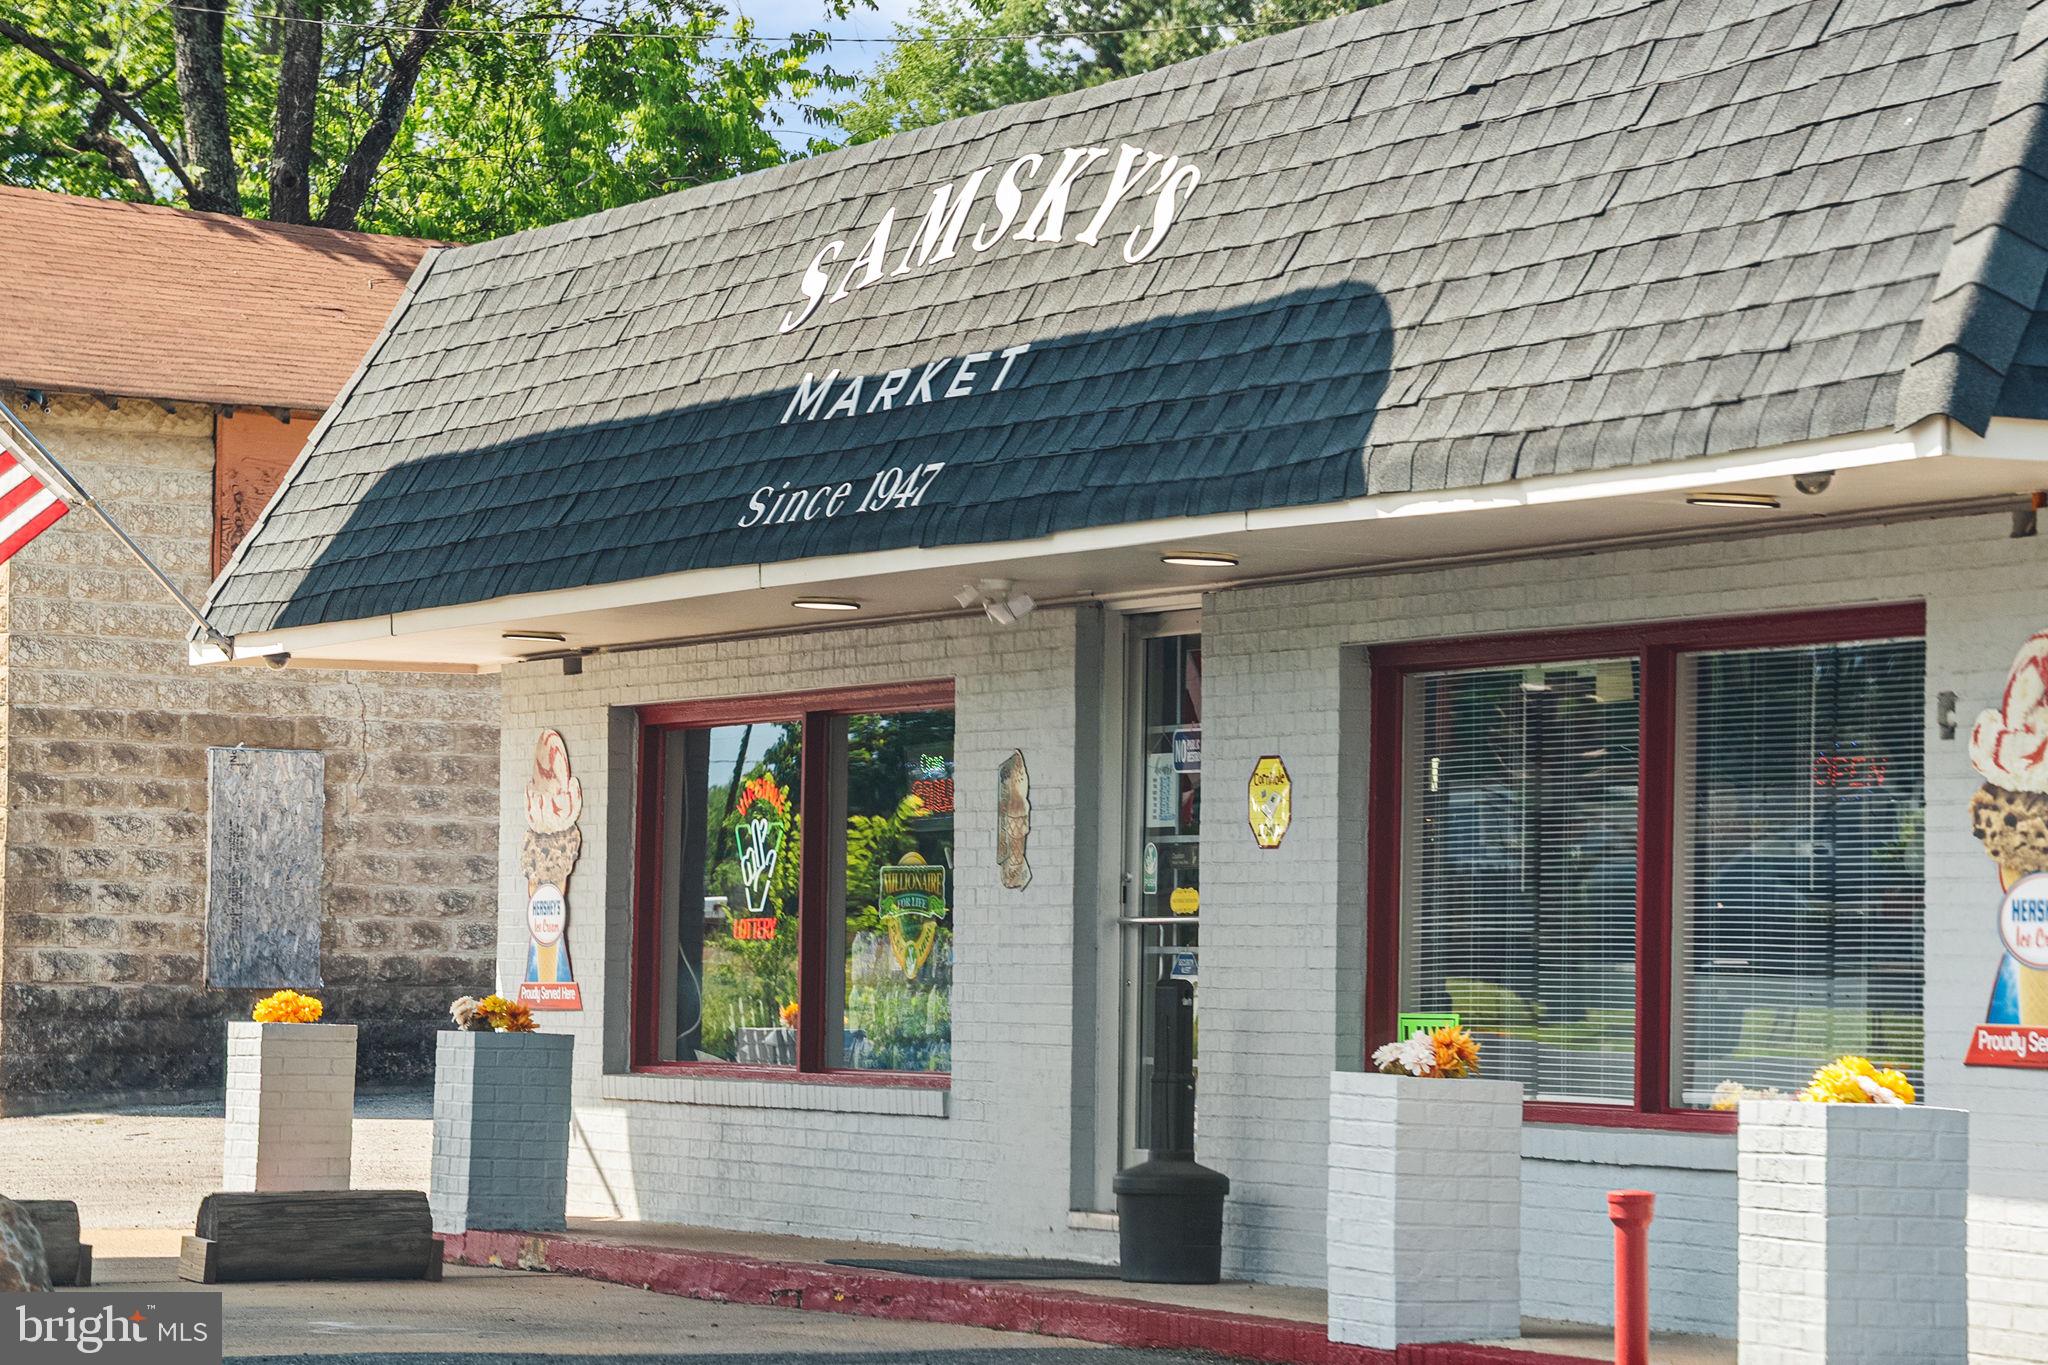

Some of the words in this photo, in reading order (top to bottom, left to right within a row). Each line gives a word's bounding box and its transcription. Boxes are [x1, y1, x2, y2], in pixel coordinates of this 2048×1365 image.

[779, 143, 1201, 333] SAMSKY'S
[780, 344, 1030, 424] MARKET
[738, 482, 853, 528] Since
[856, 462, 946, 513] 1947
[1175, 739, 1187, 763] NO
[883, 872, 944, 894] MILLIONAIRE
[533, 900, 560, 916] HERSHEY'S
[733, 917, 777, 940] LOTTERY
[2016, 926, 2032, 947] Ice
[521, 986, 540, 1003] Proudly
[541, 986, 561, 1000] Served
[562, 986, 576, 1000] Here
[1978, 1029, 2027, 1058] Proudly
